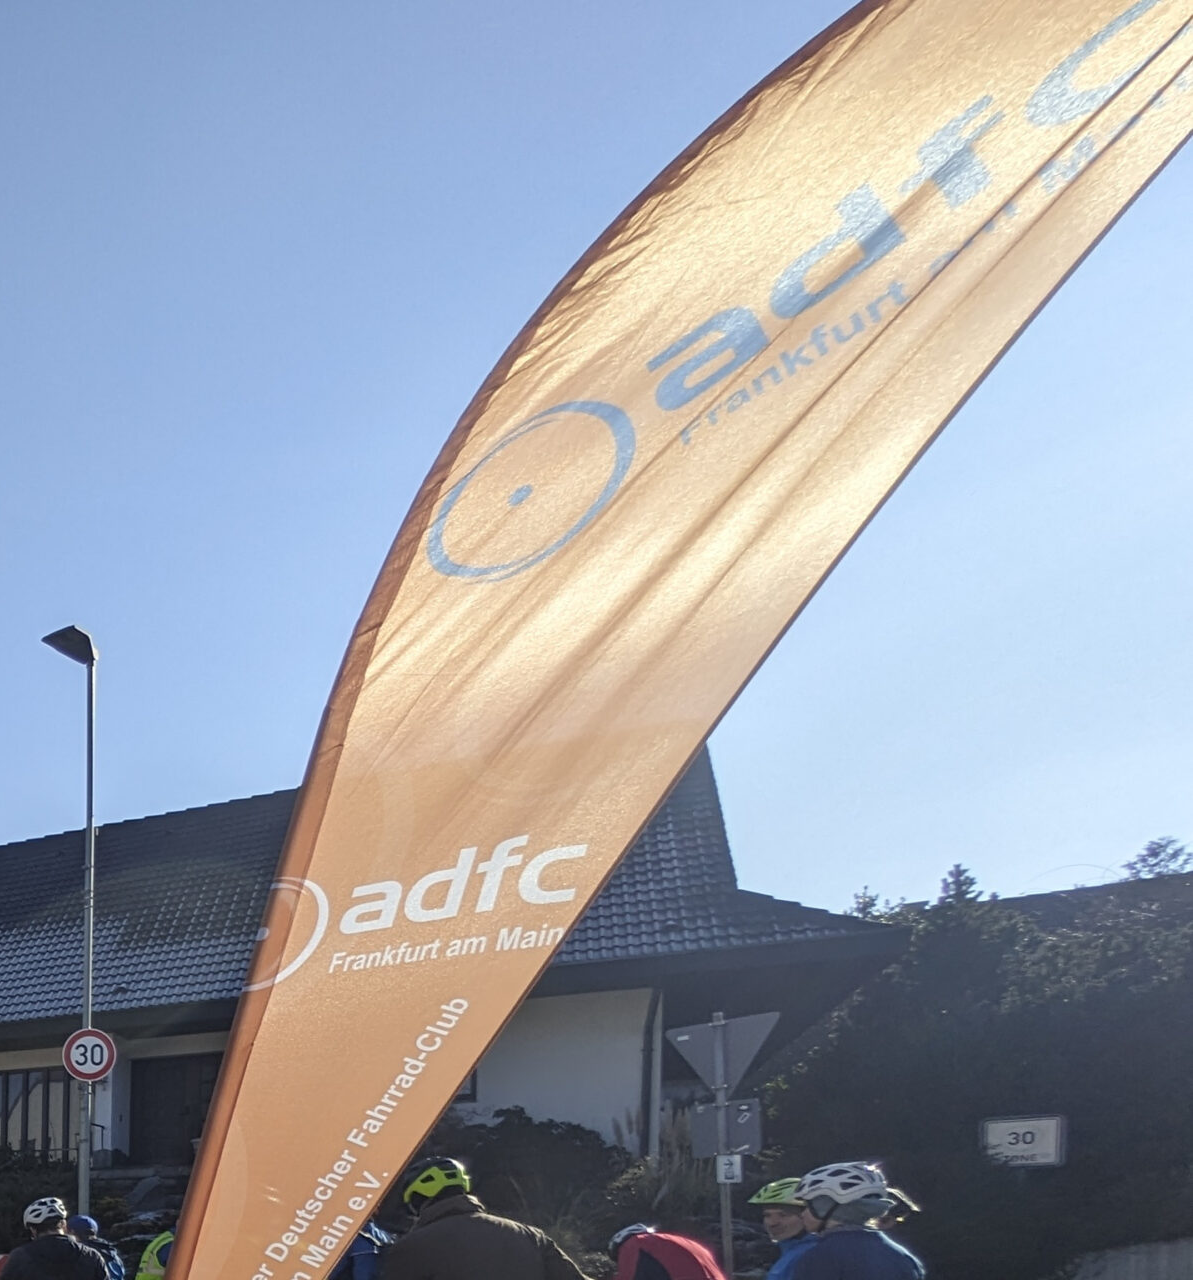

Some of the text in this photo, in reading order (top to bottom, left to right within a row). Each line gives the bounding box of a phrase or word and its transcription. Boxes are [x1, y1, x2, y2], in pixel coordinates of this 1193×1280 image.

[647, 0, 1166, 412] adfc
[679, 280, 907, 446] Frankfurt
[338, 834, 589, 935] adfc
[327, 923, 566, 974] Frankfurt am Main
[75, 1044, 103, 1066] 30
[264, 1148, 359, 1262] Deutscher
[346, 997, 470, 1149] Fahrrad-Club
[1007, 1131, 1035, 1146] 30
[300, 1214, 346, 1270] Main
[347, 1168, 391, 1212] e.V.
